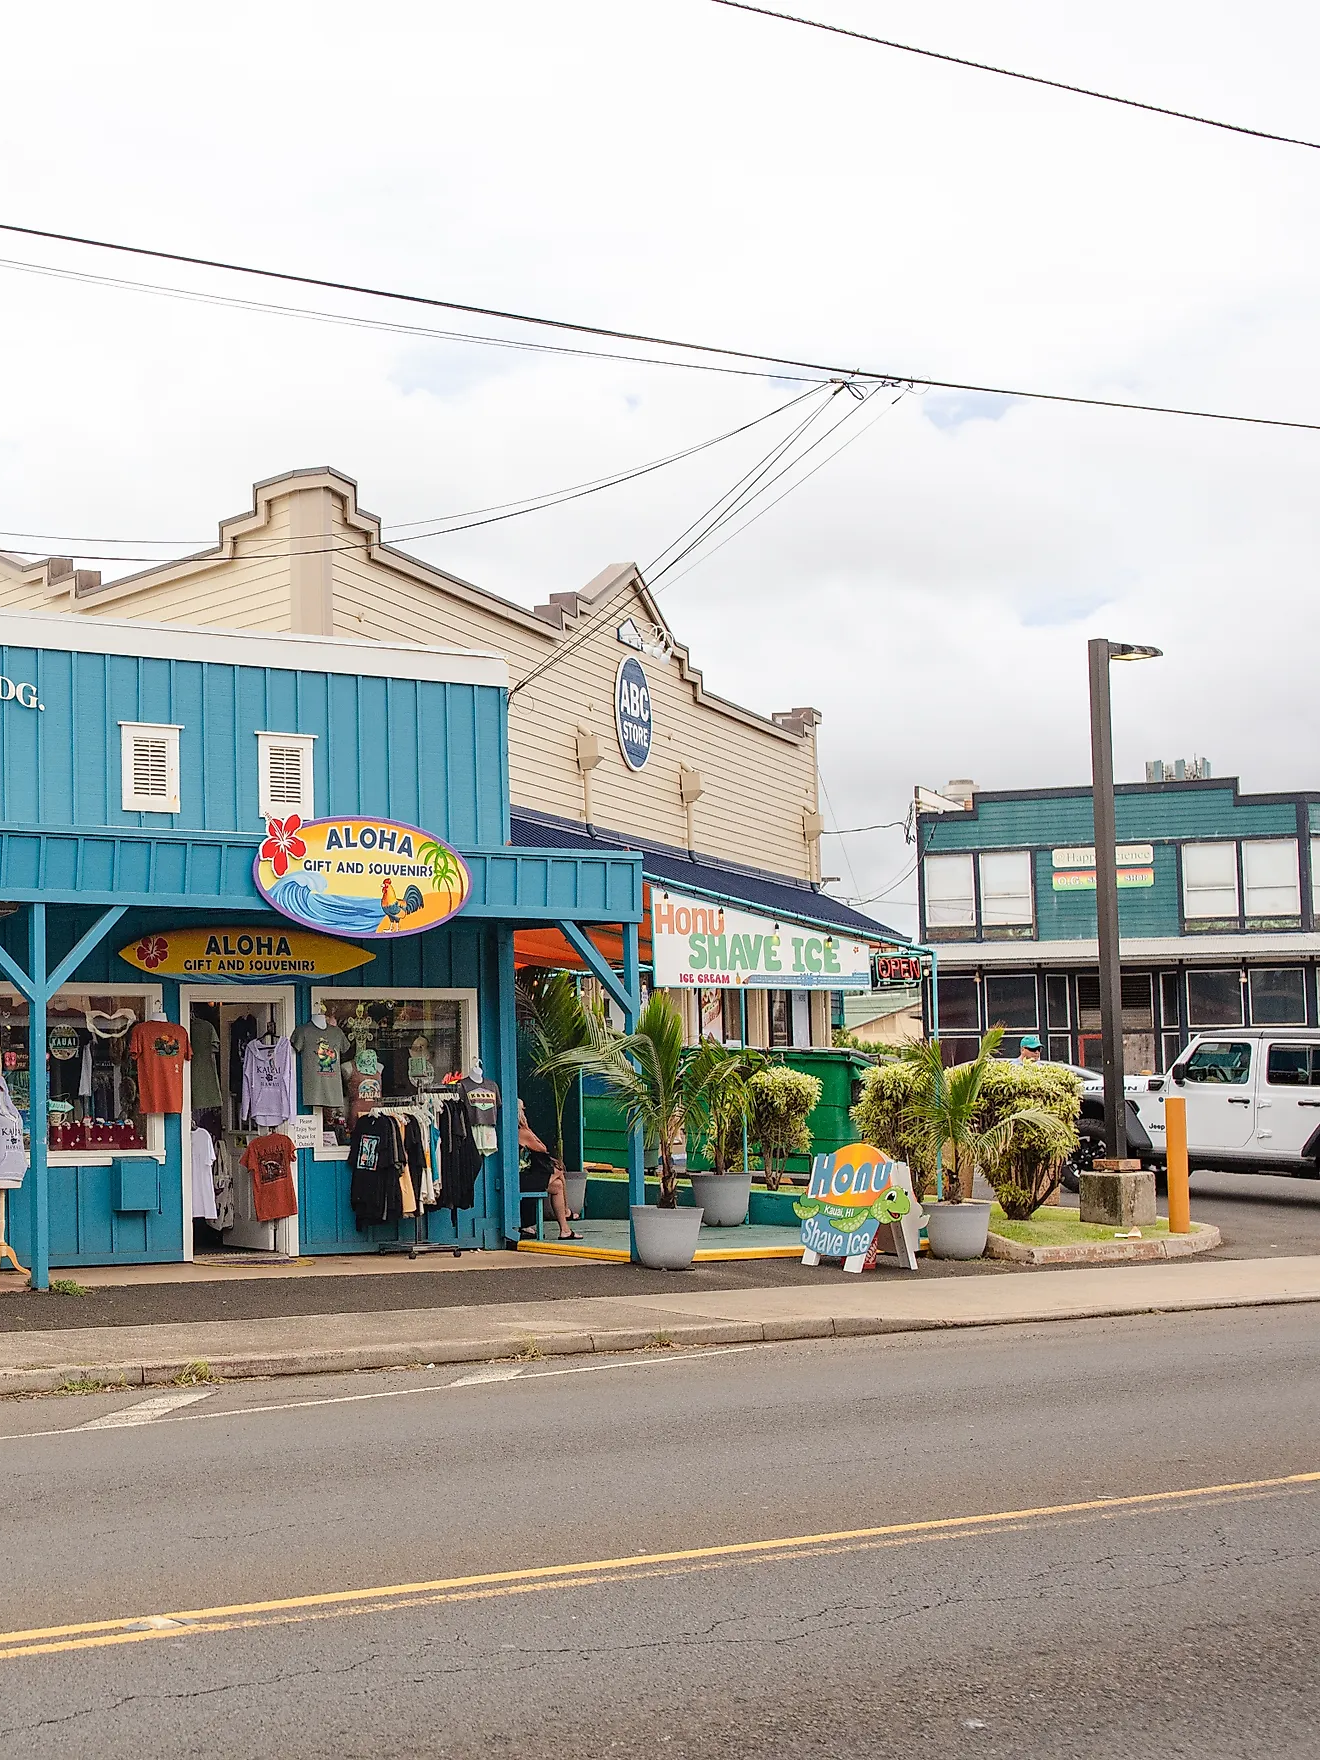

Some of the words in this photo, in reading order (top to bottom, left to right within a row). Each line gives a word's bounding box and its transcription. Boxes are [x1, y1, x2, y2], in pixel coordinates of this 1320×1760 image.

[621, 679, 650, 722] ABC
[623, 720, 649, 748] STORE
[326, 828, 414, 858] ALOHA
[303, 859, 332, 873] GIFT
[336, 861, 365, 875] AND
[369, 862, 433, 877] SOUVENIRS
[1066, 851, 1096, 864] Happ
[654, 903, 726, 937] Honu
[205, 935, 292, 956] ALOHA
[688, 932, 782, 972] SHAVE
[791, 937, 841, 974] ICE
[183, 960, 214, 971] GIFT
[217, 960, 246, 971] AND
[249, 960, 316, 972] SOUVENIRS
[878, 958, 920, 979] OPEN
[679, 973, 695, 983] ICE
[697, 973, 730, 984] CREAM
[1149, 1123, 1166, 1131] Jeep
[807, 1153, 893, 1198] Honu
[824, 1204, 844, 1218] Kauai,
[801, 1218, 843, 1255] Shave
[846, 1232, 870, 1255] Ice
